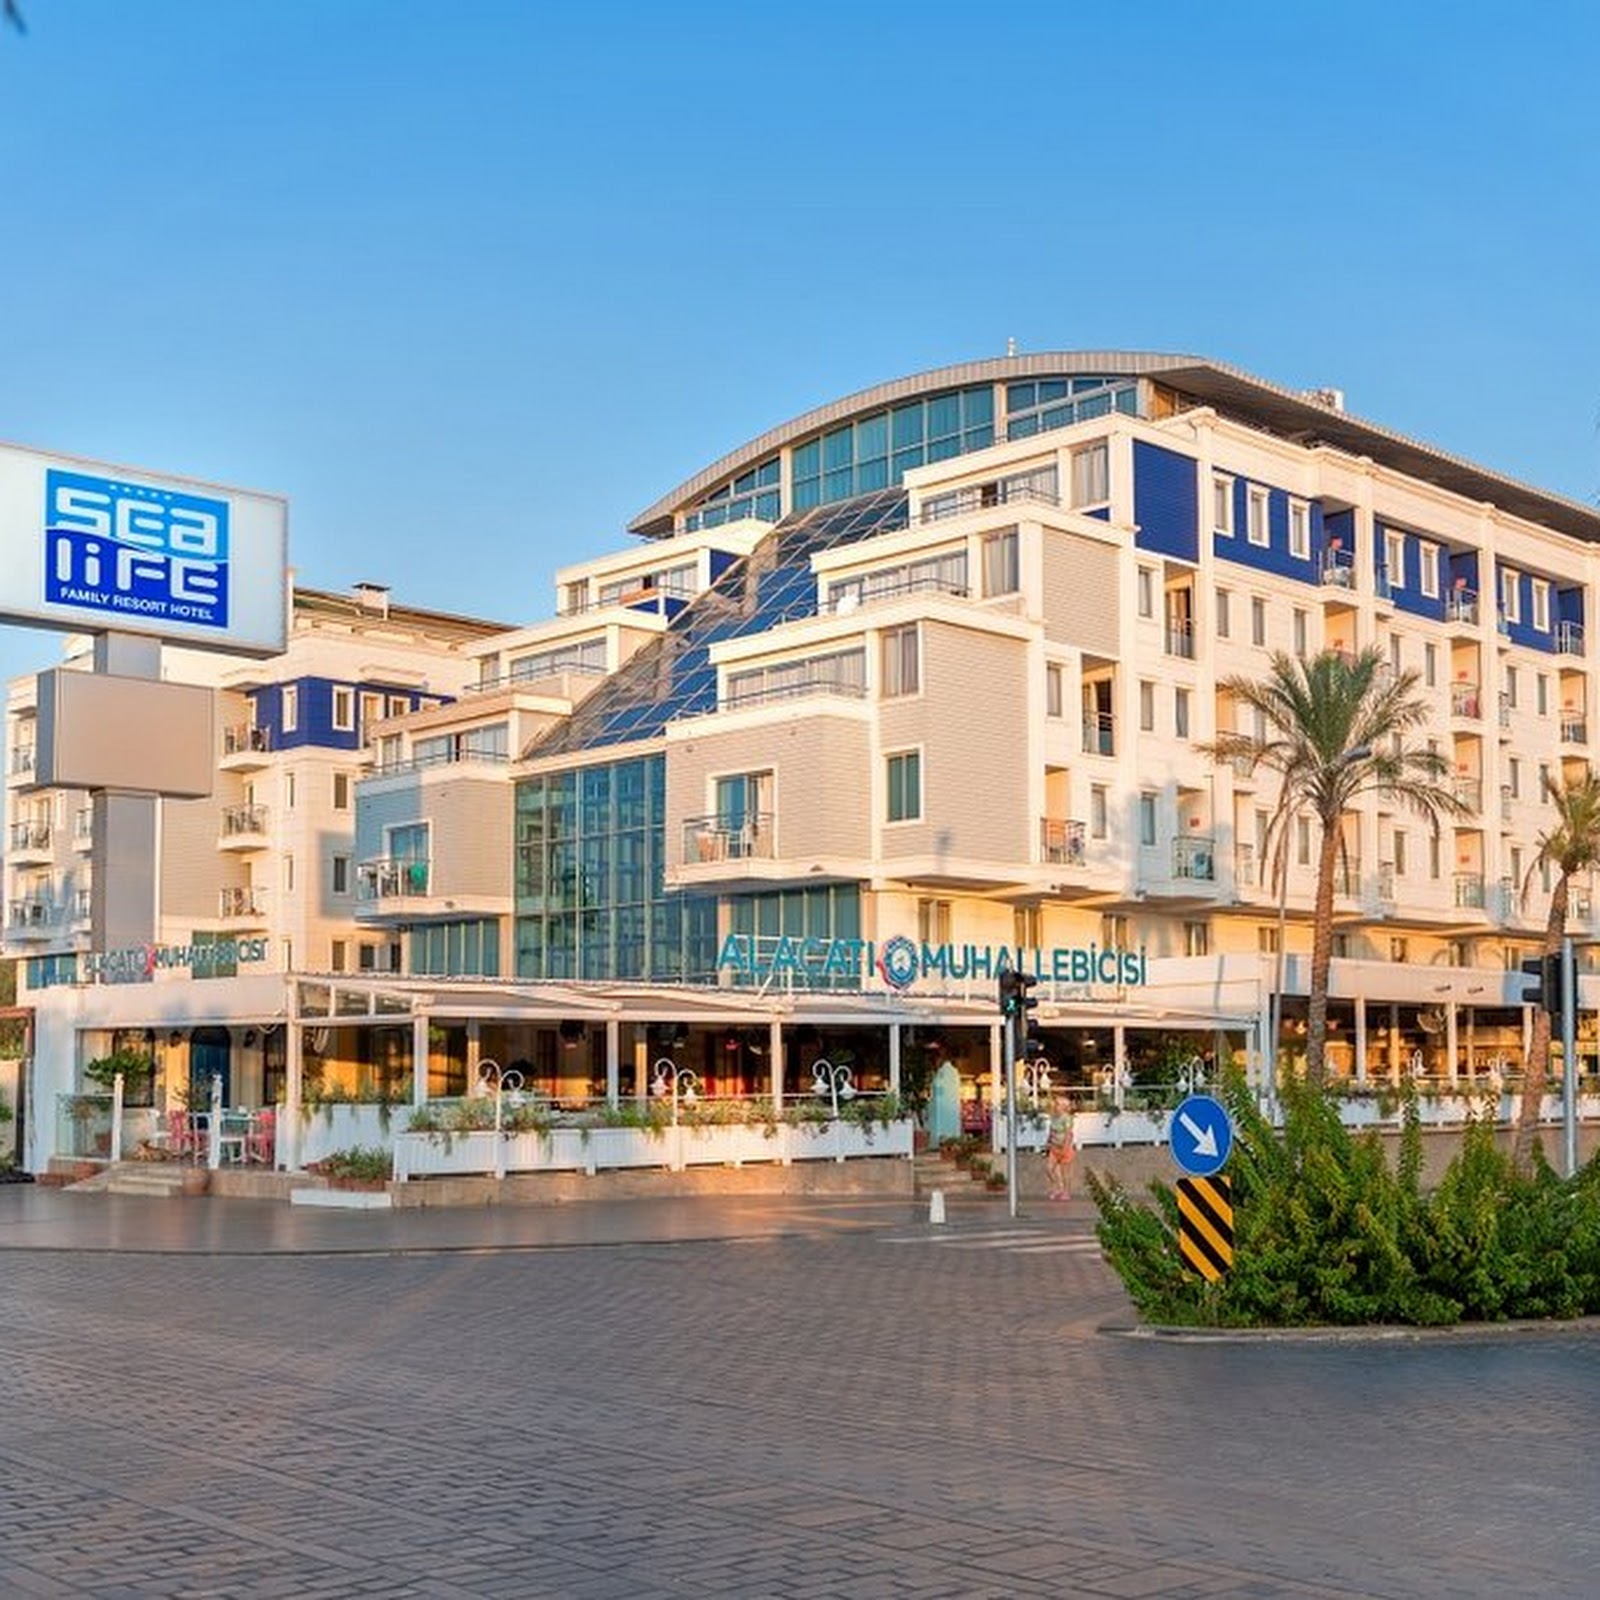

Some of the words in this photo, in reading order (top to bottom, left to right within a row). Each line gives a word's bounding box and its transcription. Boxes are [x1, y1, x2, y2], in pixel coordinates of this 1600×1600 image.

[60, 586, 110, 604] FAMILY
[112, 593, 168, 615] RESORT
[170, 604, 214, 621] HOTEL
